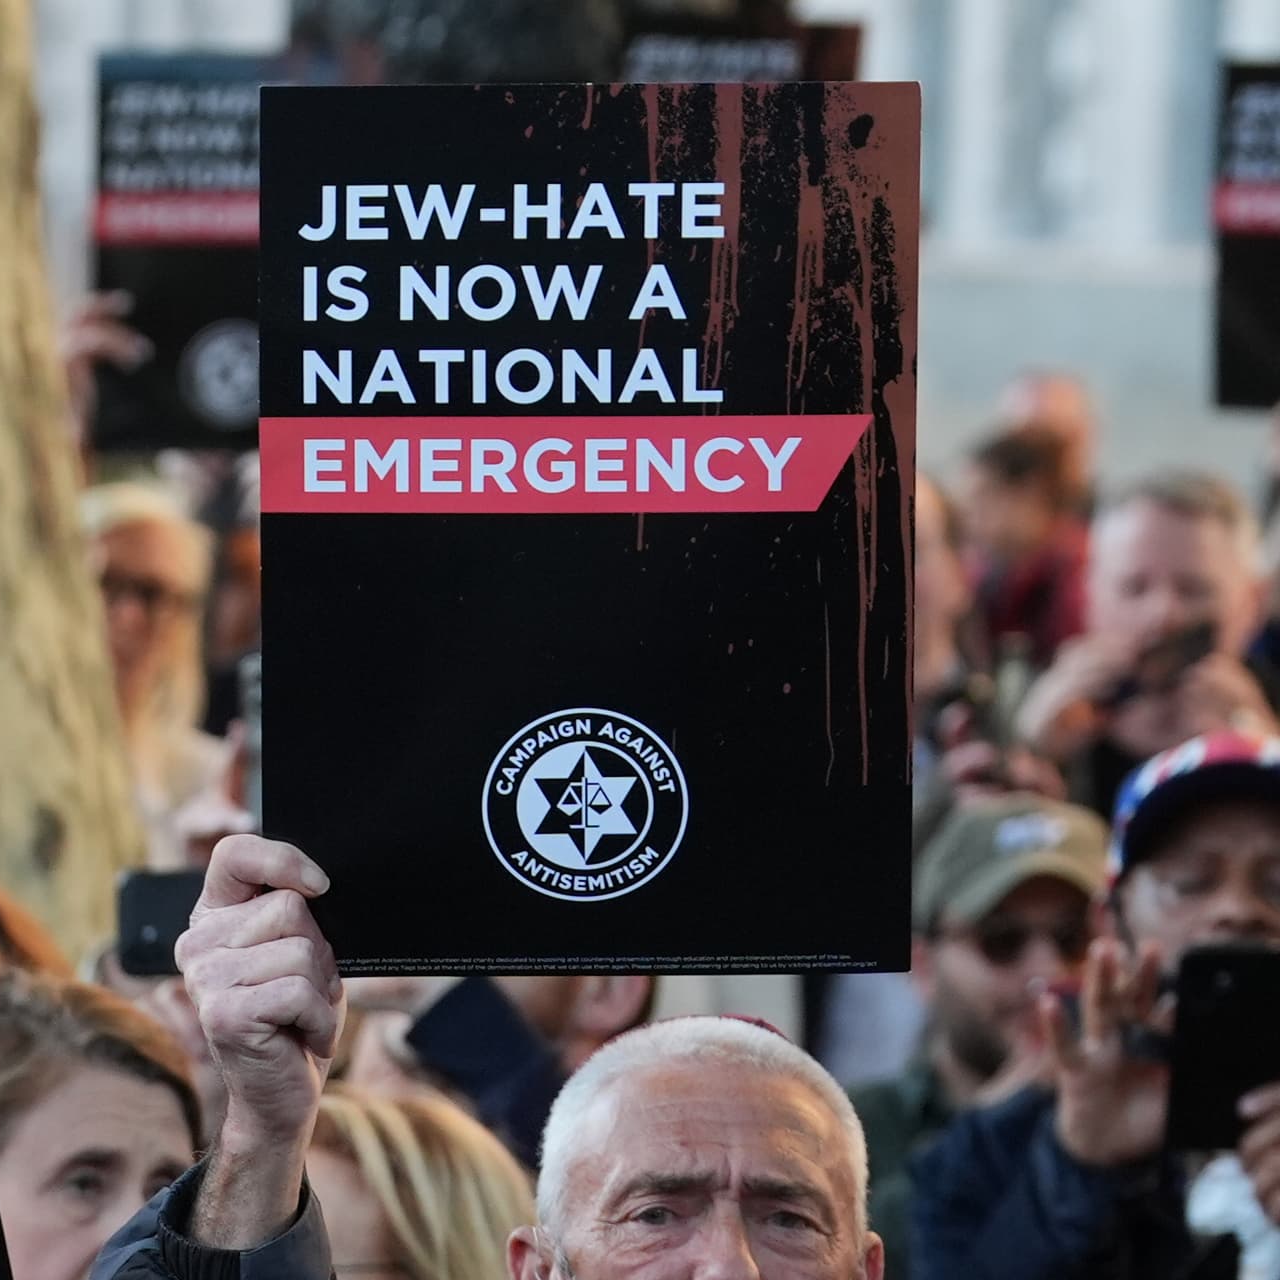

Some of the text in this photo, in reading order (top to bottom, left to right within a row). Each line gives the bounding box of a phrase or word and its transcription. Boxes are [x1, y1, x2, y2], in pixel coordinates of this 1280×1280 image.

[298, 182, 725, 241] JEW-HATE
[303, 264, 687, 322] IS NOW A
[303, 348, 723, 404] NATIONAL
[304, 436, 802, 493] EMERGENCY
[495, 718, 676, 796] CAMPAIGN AGAINST
[510, 845, 660, 892] ANTISEMITISM
